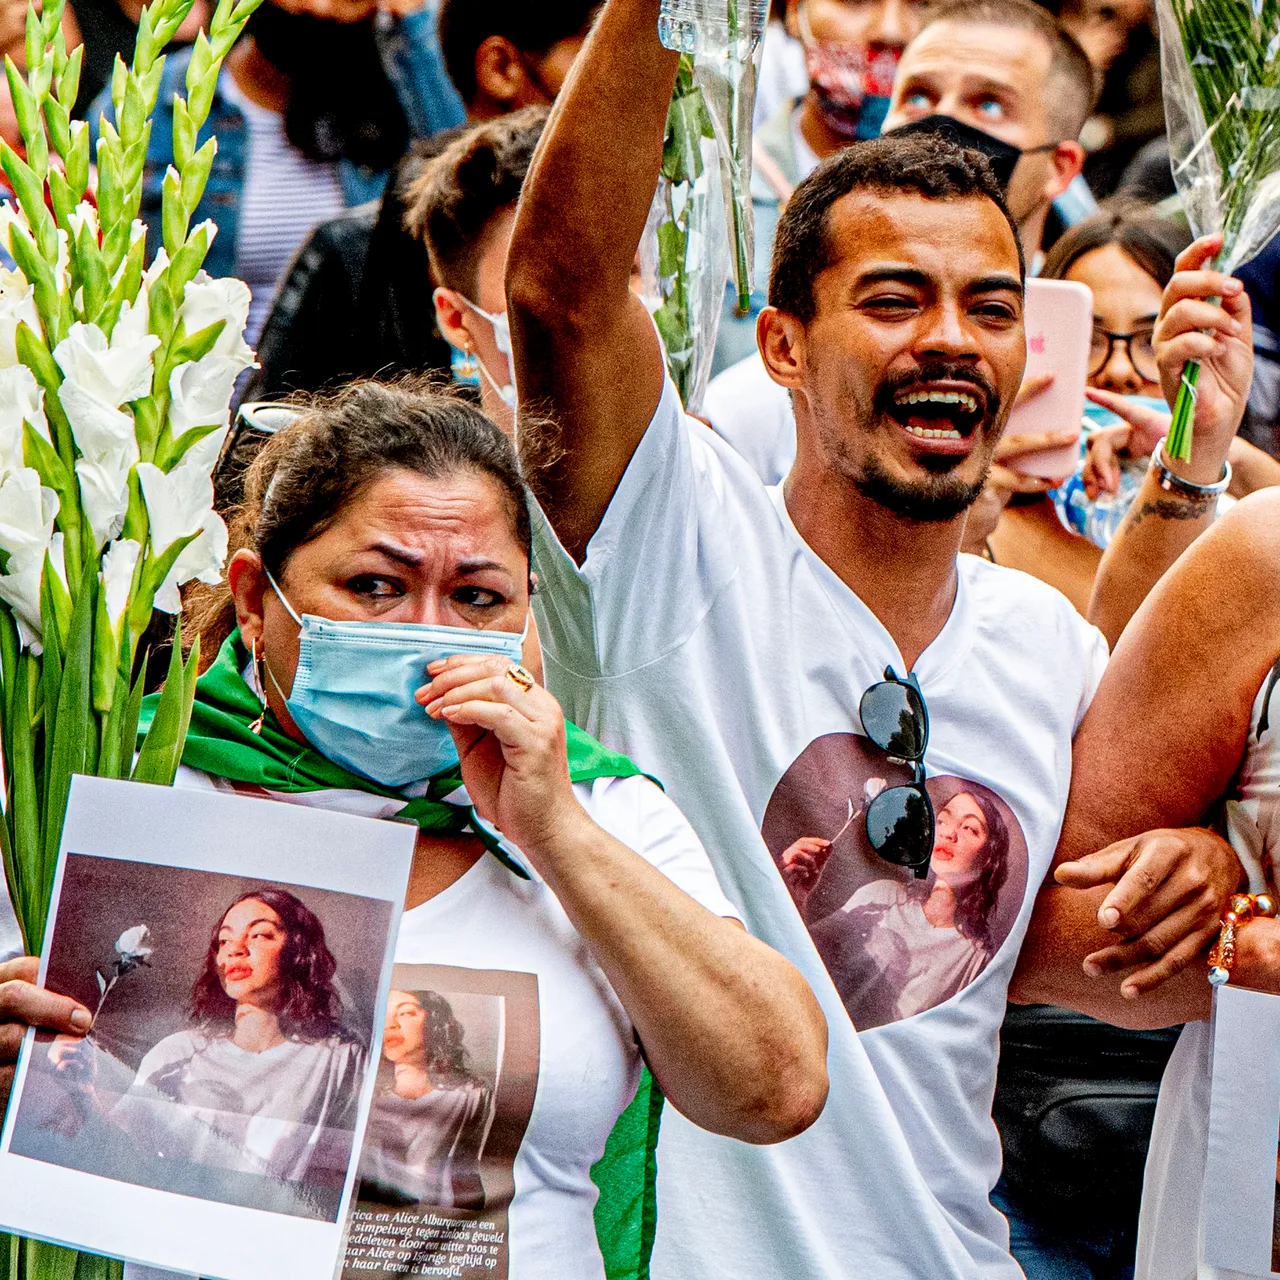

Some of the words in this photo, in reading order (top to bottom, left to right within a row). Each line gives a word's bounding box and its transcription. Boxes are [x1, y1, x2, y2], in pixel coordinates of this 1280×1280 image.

[351, 1210, 373, 1220] rica
[376, 1213, 389, 1222] en
[391, 1212, 419, 1224] Alice
[420, 1214, 477, 1230] Alburquerque
[478, 1222, 496, 1230] een
[348, 1233, 396, 1247] edeleven
[399, 1237, 425, 1249] door
[426, 1242, 439, 1250] een
[440, 1240, 464, 1252] witte
[466, 1244, 487, 1254] roos
[490, 1246, 498, 1255] te
[354, 1222, 413, 1238] simpelweg
[416, 1228, 440, 1240] tegen
[440, 1229, 470, 1240] zinloos
[472, 1232, 504, 1244] geweld
[352, 1258, 381, 1270] haar
[382, 1260, 410, 1273] leven
[411, 1263, 420, 1274] is
[421, 1263, 463, 1278] beroofd.
[366, 1246, 395, 1259] Alice
[397, 1253, 412, 1262] op
[448, 1253, 483, 1268] leeftijd
[484, 1258, 497, 1270] op
